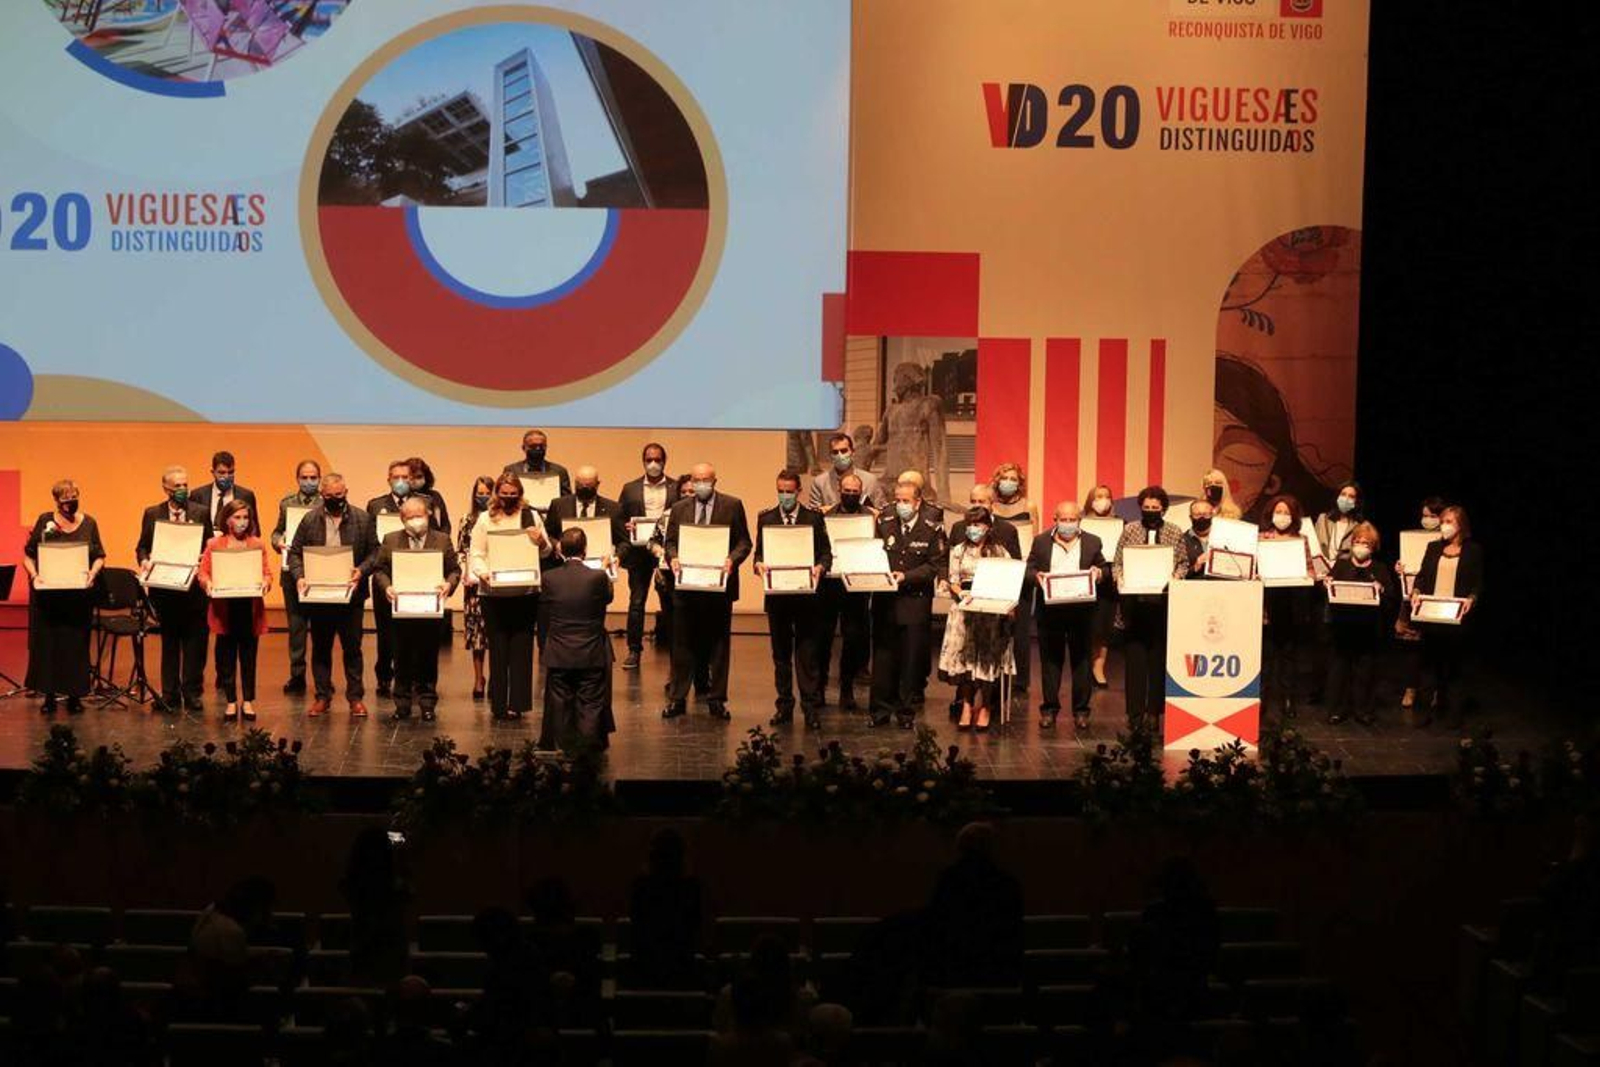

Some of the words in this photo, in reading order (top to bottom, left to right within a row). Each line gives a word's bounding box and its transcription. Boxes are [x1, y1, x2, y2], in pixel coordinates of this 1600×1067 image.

[1168, 21, 1265, 40] RECONQUISTA
[1269, 23, 1286, 40] DE
[1290, 24, 1323, 40] VIGO
[0, 191, 92, 252] 20
